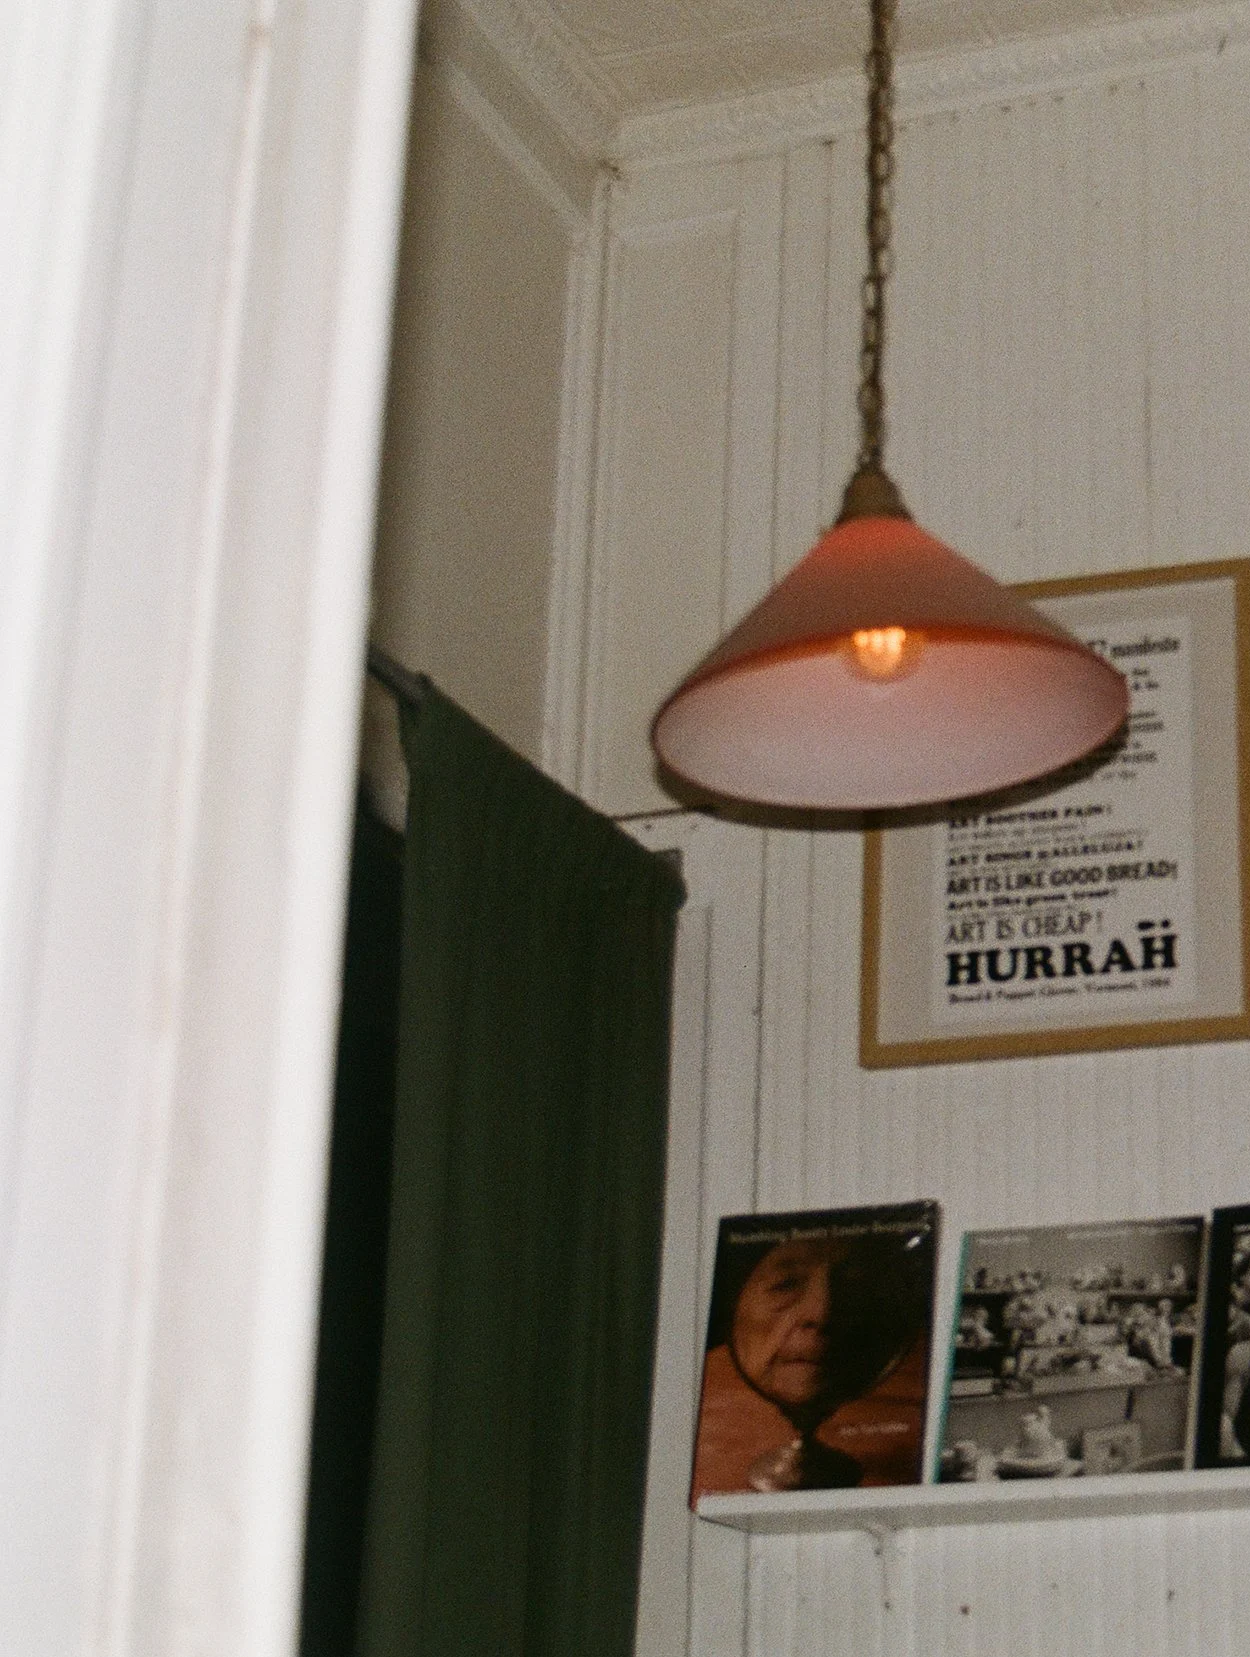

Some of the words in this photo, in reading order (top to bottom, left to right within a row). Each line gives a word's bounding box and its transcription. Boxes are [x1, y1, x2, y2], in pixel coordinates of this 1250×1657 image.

[947, 876, 981, 894] ART
[984, 876, 1001, 892] IS
[1005, 871, 1046, 890] LIKE
[1050, 866, 1103, 886] GOOD
[946, 918, 986, 943] ART
[996, 917, 1016, 940] IS
